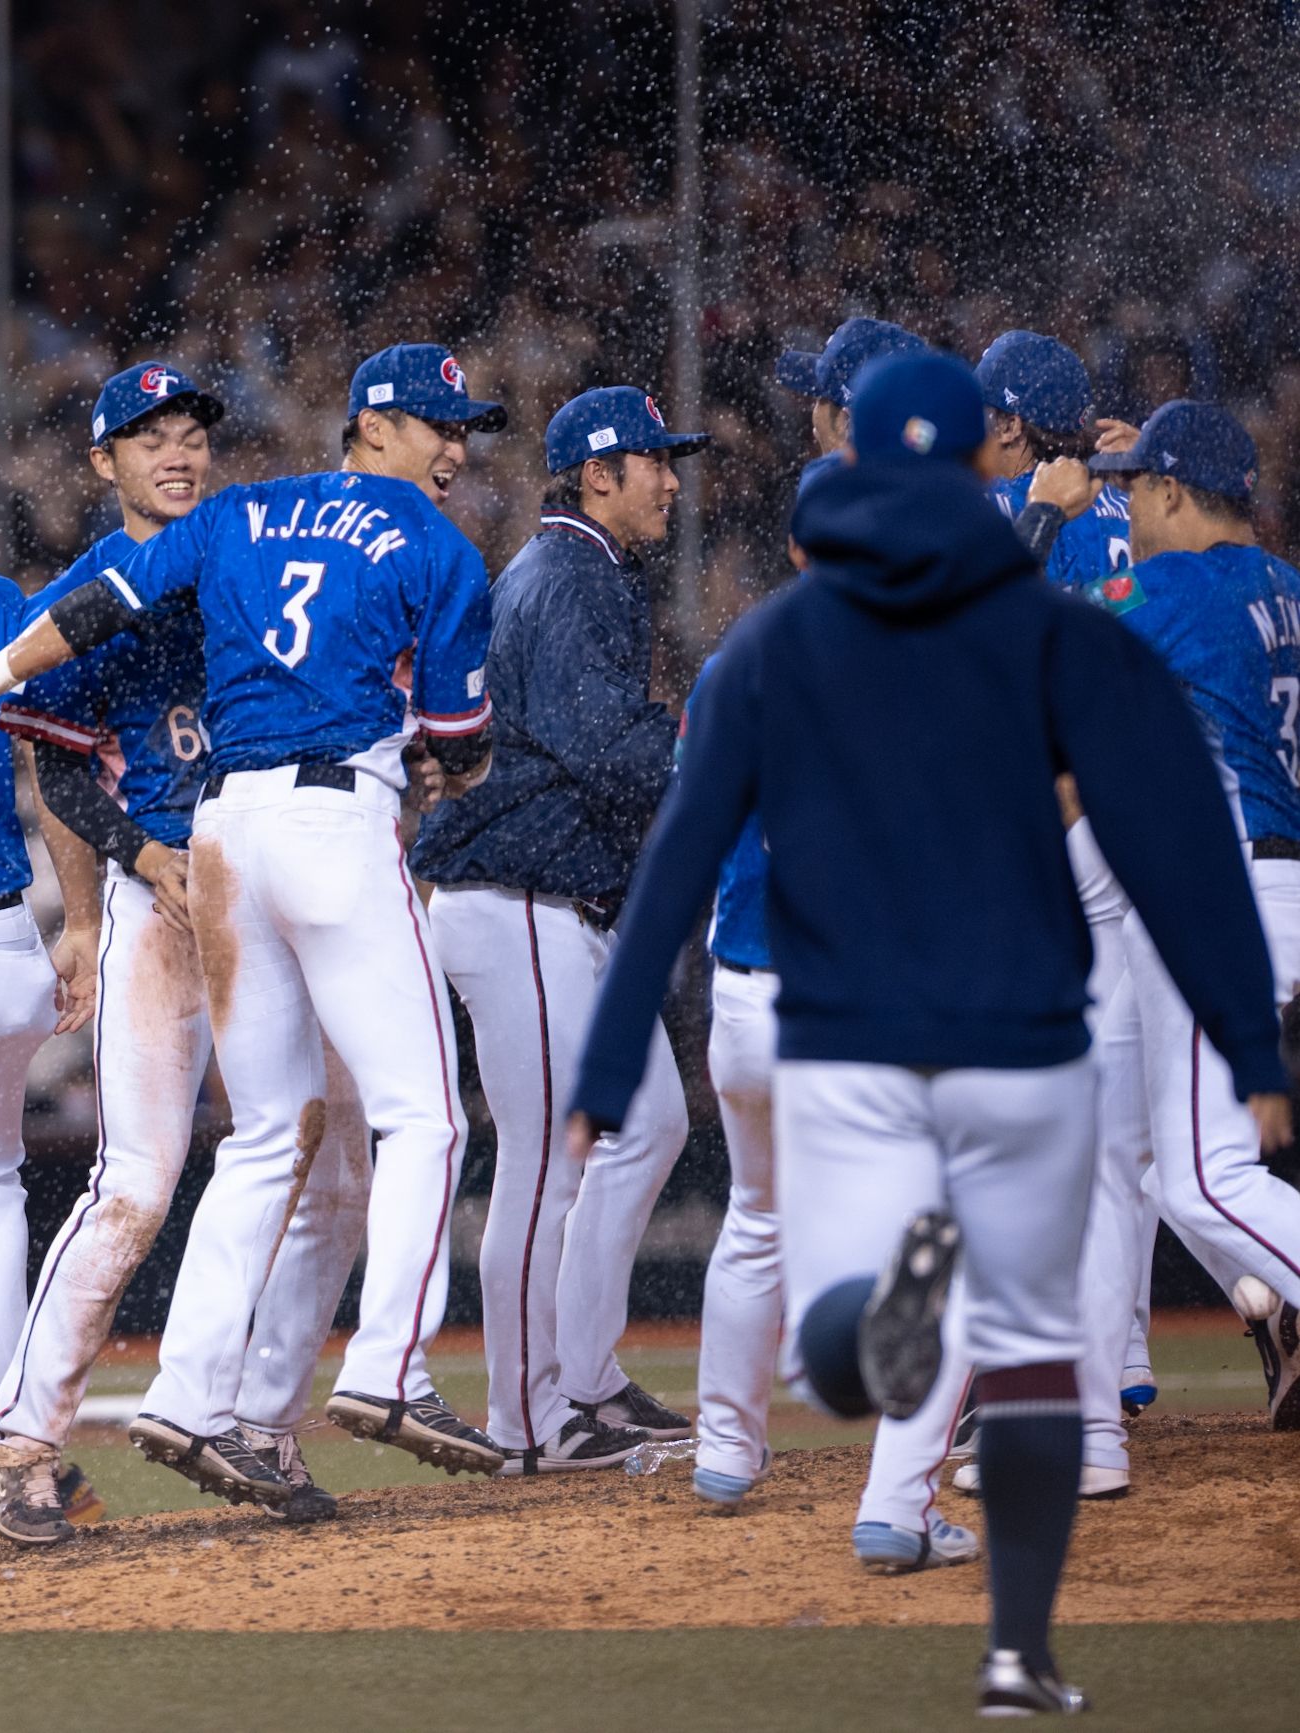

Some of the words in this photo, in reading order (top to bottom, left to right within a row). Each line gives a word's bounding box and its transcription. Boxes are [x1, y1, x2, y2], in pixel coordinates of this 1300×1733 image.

[246, 498, 408, 564] W.J.CHEN
[262, 560, 327, 670] 3
[168, 704, 202, 761] 6
